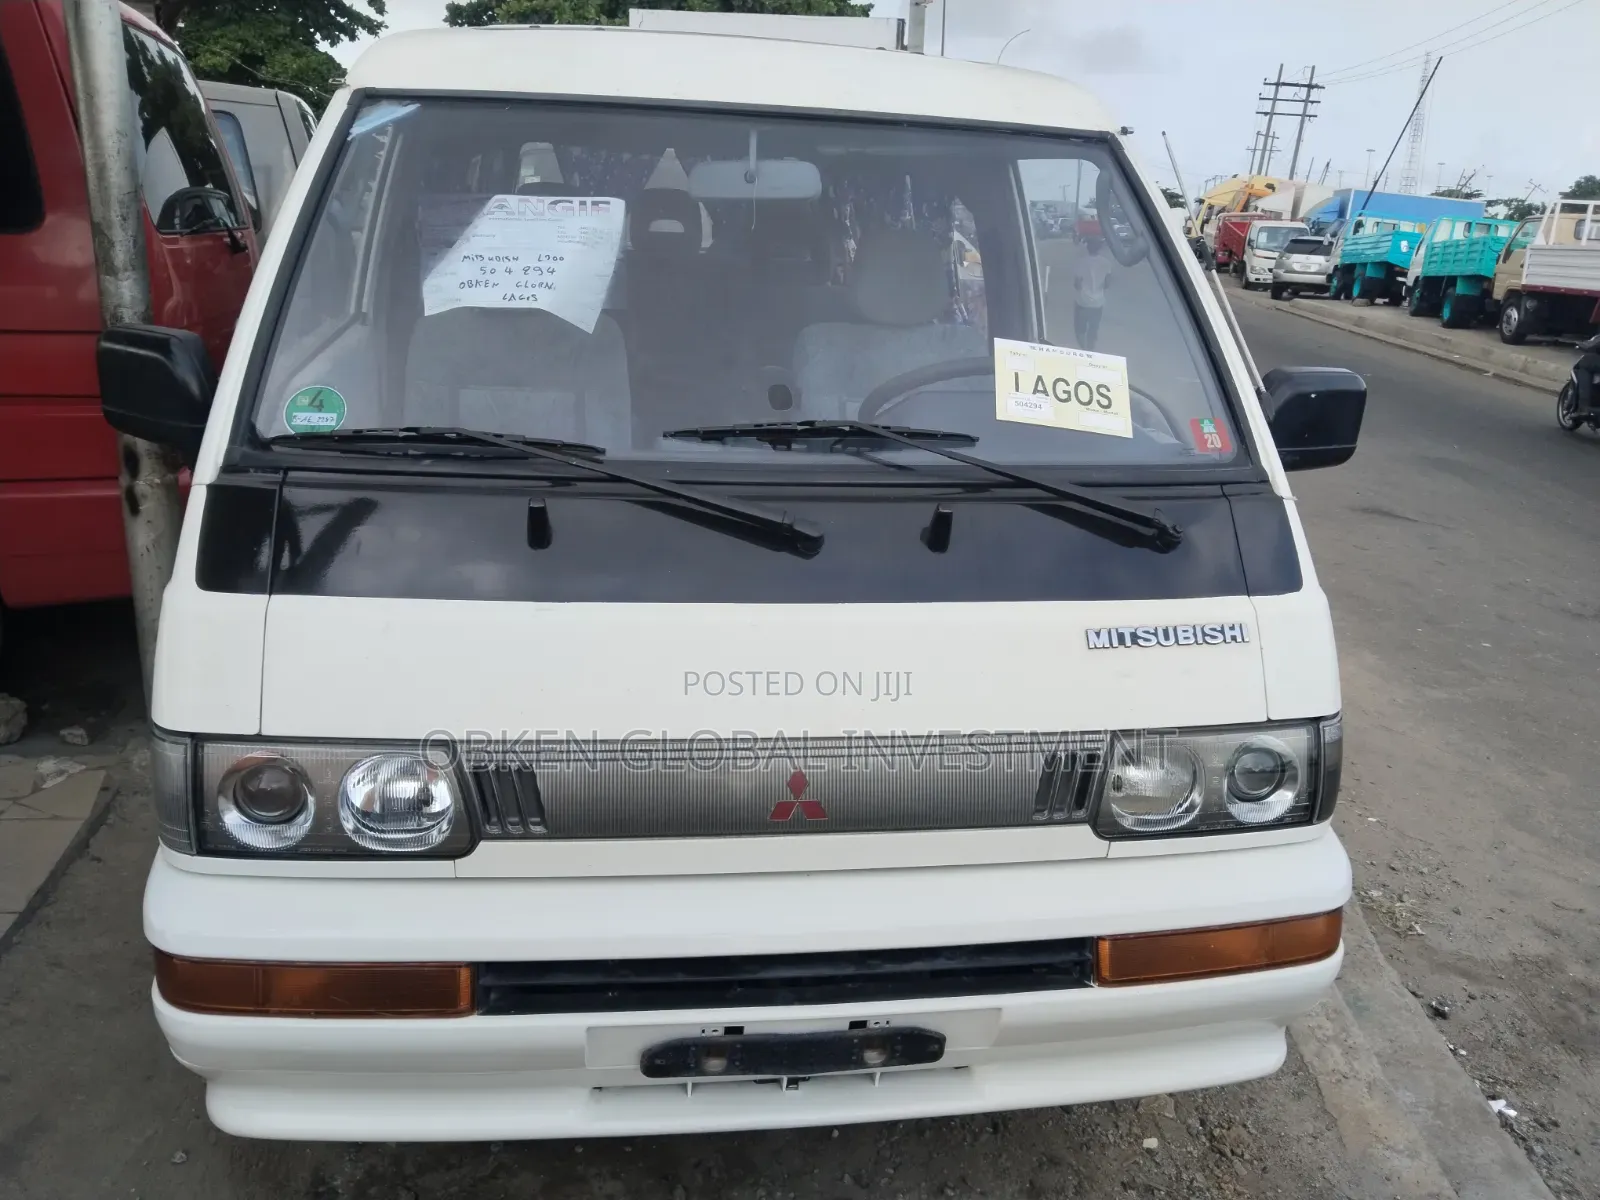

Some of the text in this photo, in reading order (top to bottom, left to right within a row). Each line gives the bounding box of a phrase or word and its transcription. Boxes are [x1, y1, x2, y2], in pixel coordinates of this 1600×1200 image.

[308, 389, 325, 413] 4
[1014, 400, 1043, 410] 504294
[1203, 433, 1222, 449] 20
[1086, 622, 1250, 650] MITSUBISHI
